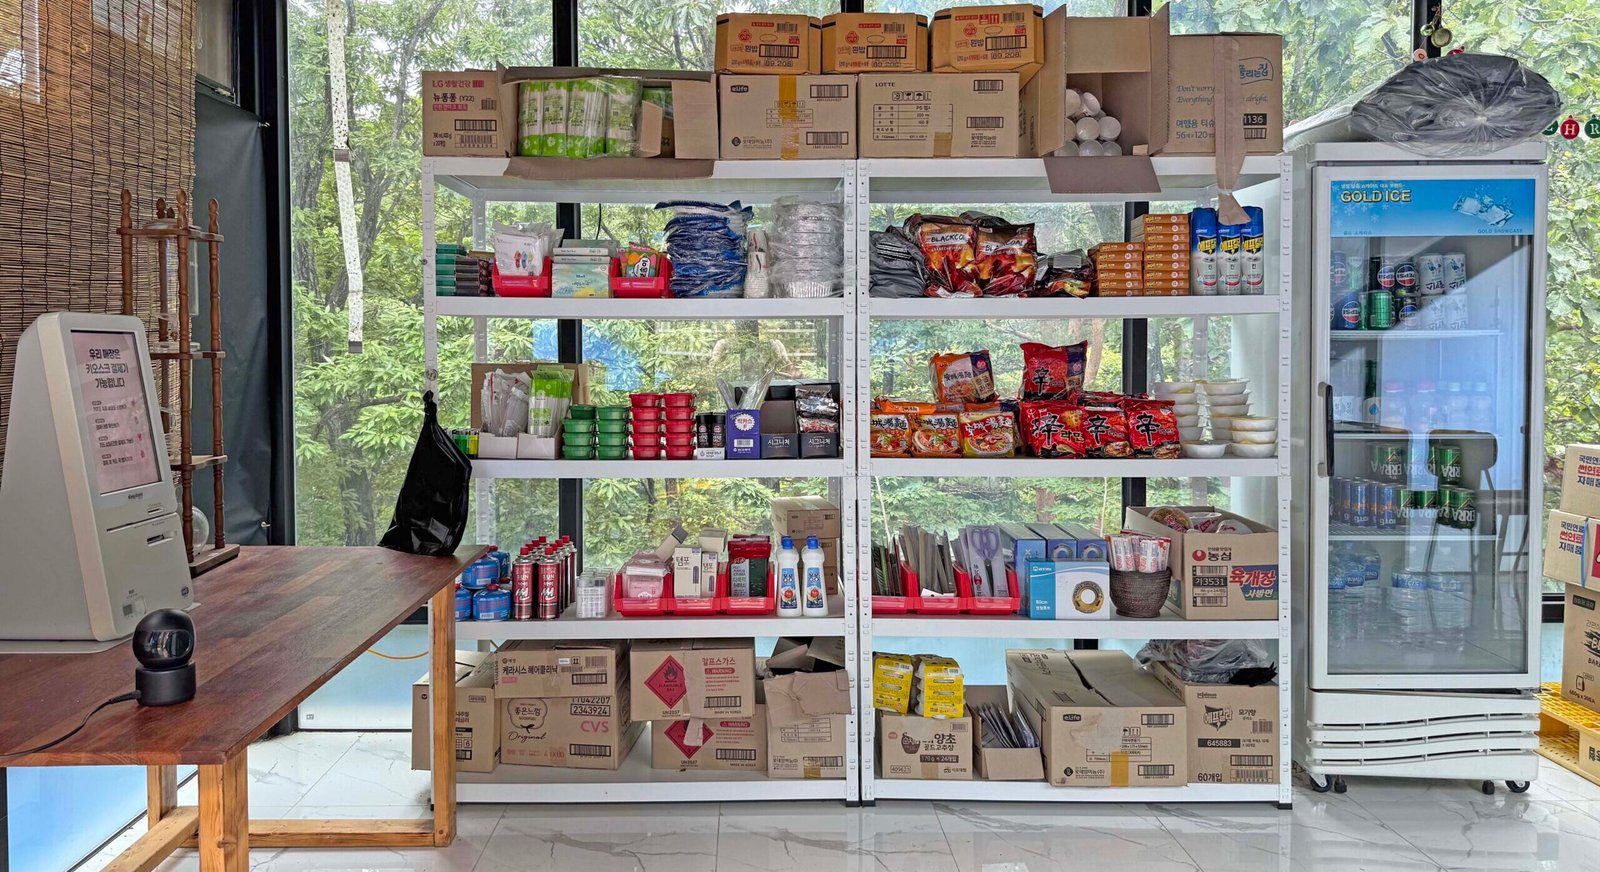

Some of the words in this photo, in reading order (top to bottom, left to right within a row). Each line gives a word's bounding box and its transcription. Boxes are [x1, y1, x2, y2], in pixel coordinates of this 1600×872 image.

[433, 80, 443, 88] LG
[433, 93, 457, 103] 뉴퐁퐁
[1176, 119, 1198, 129] 여행용
[1564, 124, 1577, 135] H
[1590, 124, 1600, 135] R
[1341, 190, 1383, 202] GOLD
[1386, 189, 1412, 202] ICE
[931, 234, 967, 243] BLACKCO
[89, 348, 102, 360] 우리
[102, 348, 121, 360] 매장은
[86, 363, 111, 374] 키오스크
[95, 377, 125, 388] 가능합니다
[1032, 367, 1053, 397] 辛
[1087, 414, 1112, 446] 辛
[1135, 411, 1160, 447] 辛
[1578, 455, 1600, 466] 국민연
[676, 556, 690, 567] 템포
[1208, 552, 1232, 561] 농심
[1195, 578, 1225, 586] 가3531
[1229, 567, 1276, 588] 육개장
[1245, 589, 1274, 599] 사발면
[503, 666, 527, 675] 케라시스
[528, 664, 558, 675] 헤어클리닉
[514, 706, 541, 716] 좋은느낌
[573, 706, 608, 715] 2343924
[1239, 708, 1257, 717] 모기향
[580, 720, 609, 733] CVS
[508, 731, 547, 744] Original
[934, 733, 957, 744] 양초
[1197, 773, 1222, 782] 60개입
